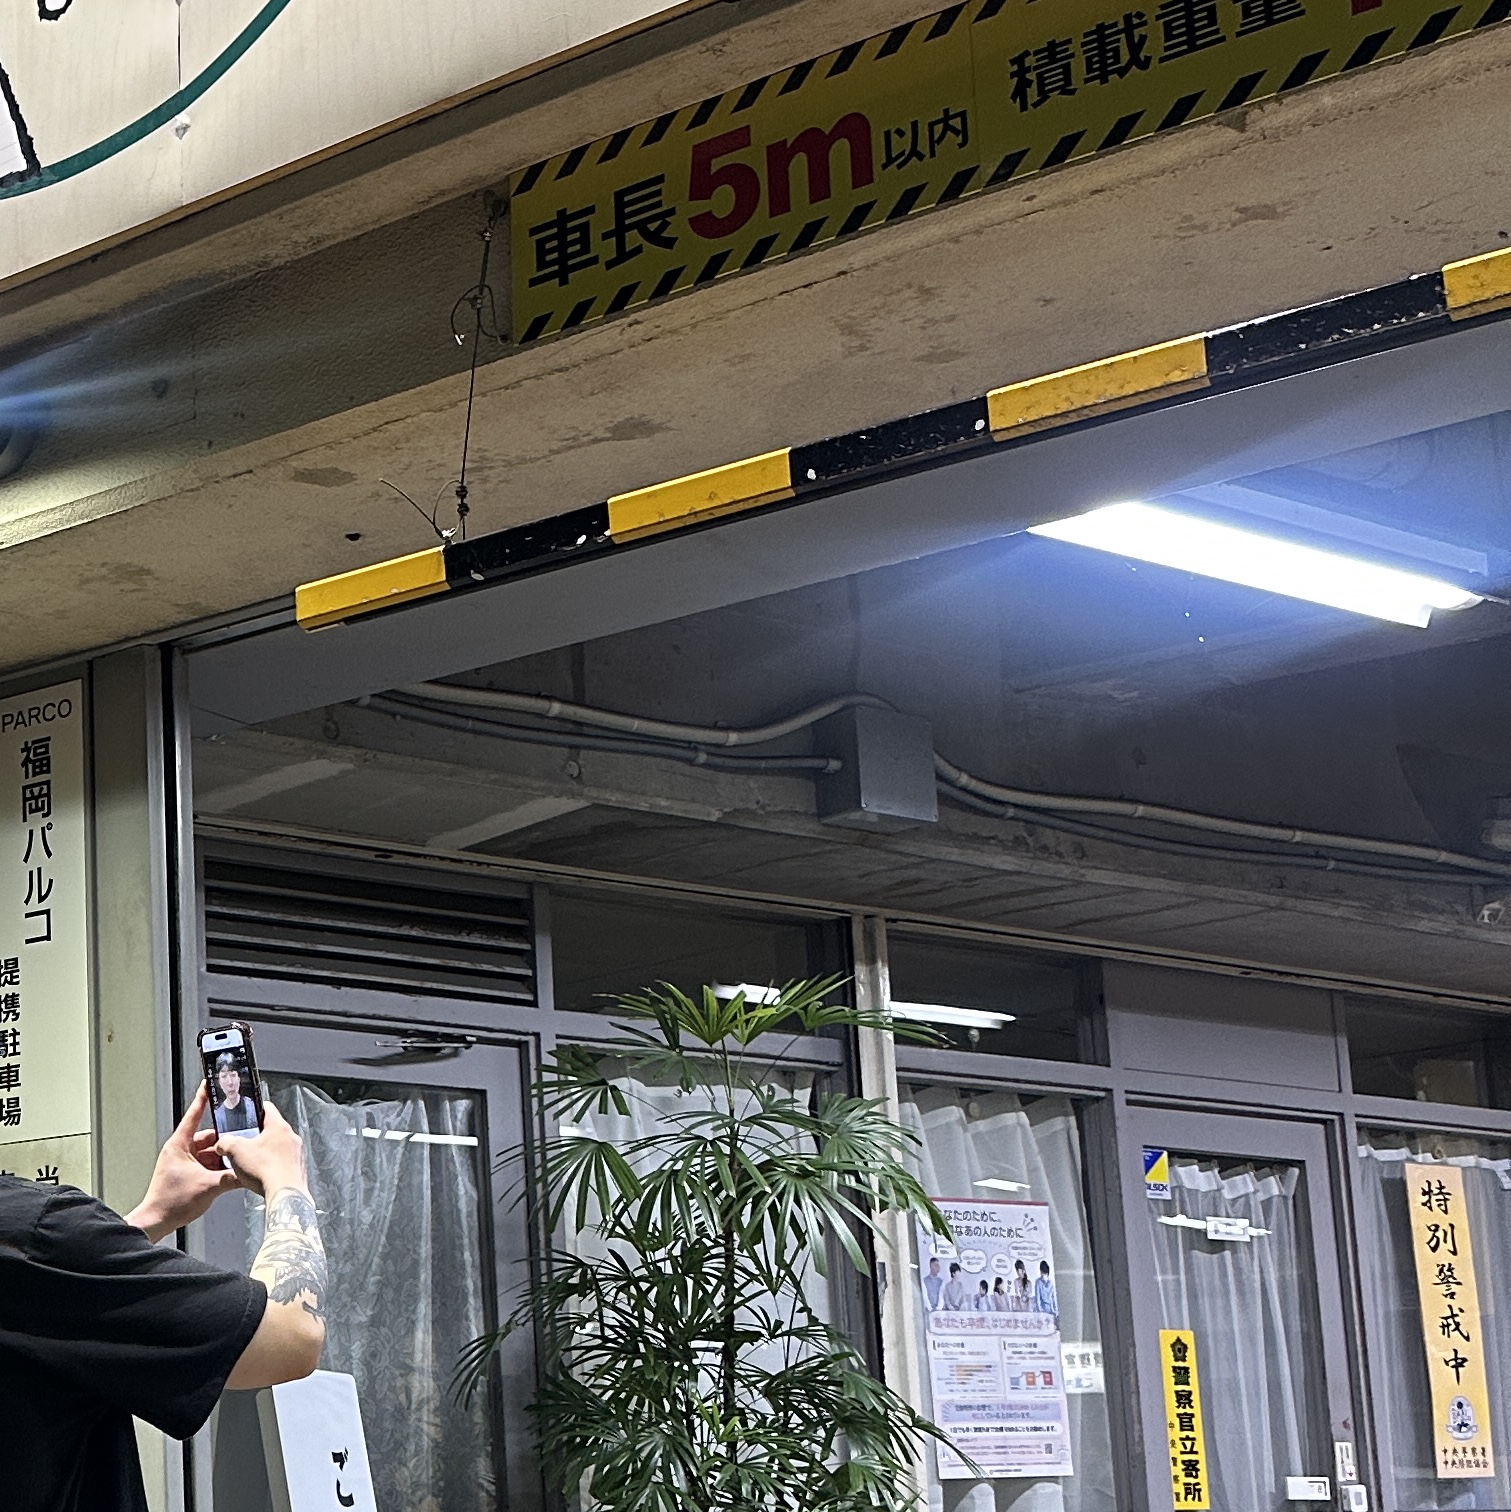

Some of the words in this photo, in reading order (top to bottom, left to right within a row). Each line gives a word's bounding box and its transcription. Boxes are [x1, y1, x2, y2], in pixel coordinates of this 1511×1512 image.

[527, 108, 969, 289] 車長5m以内
[1, 698, 73, 733] PARCO
[20, 735, 54, 945] 福岡パルコ
[1420, 1179, 1471, 1386] 特別警戒中
[1171, 1365, 1203, 1503] 警察官立寄所
